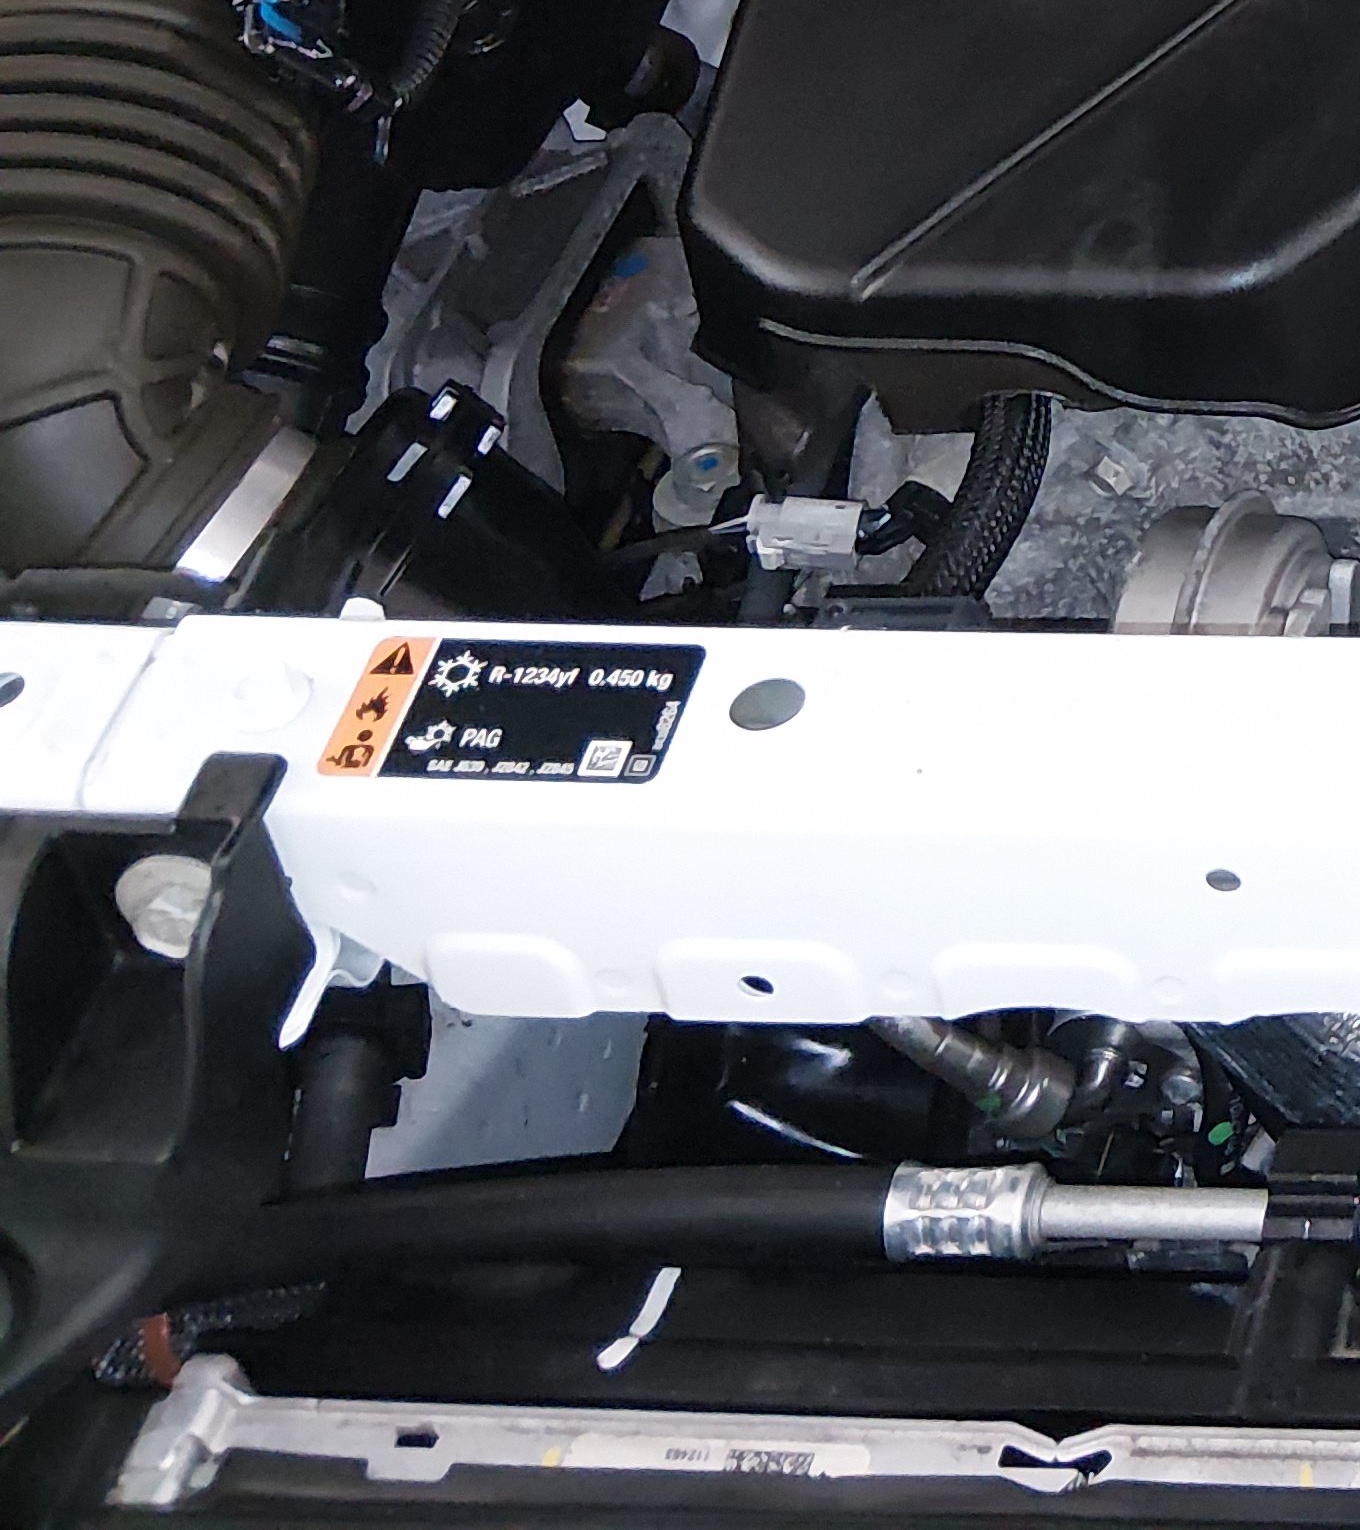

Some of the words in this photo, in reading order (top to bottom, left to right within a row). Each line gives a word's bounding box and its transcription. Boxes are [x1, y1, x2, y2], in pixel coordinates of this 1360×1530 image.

[588, 669, 645, 687] 0.450
[646, 670, 673, 691] kg
[460, 728, 503, 749] PAG
